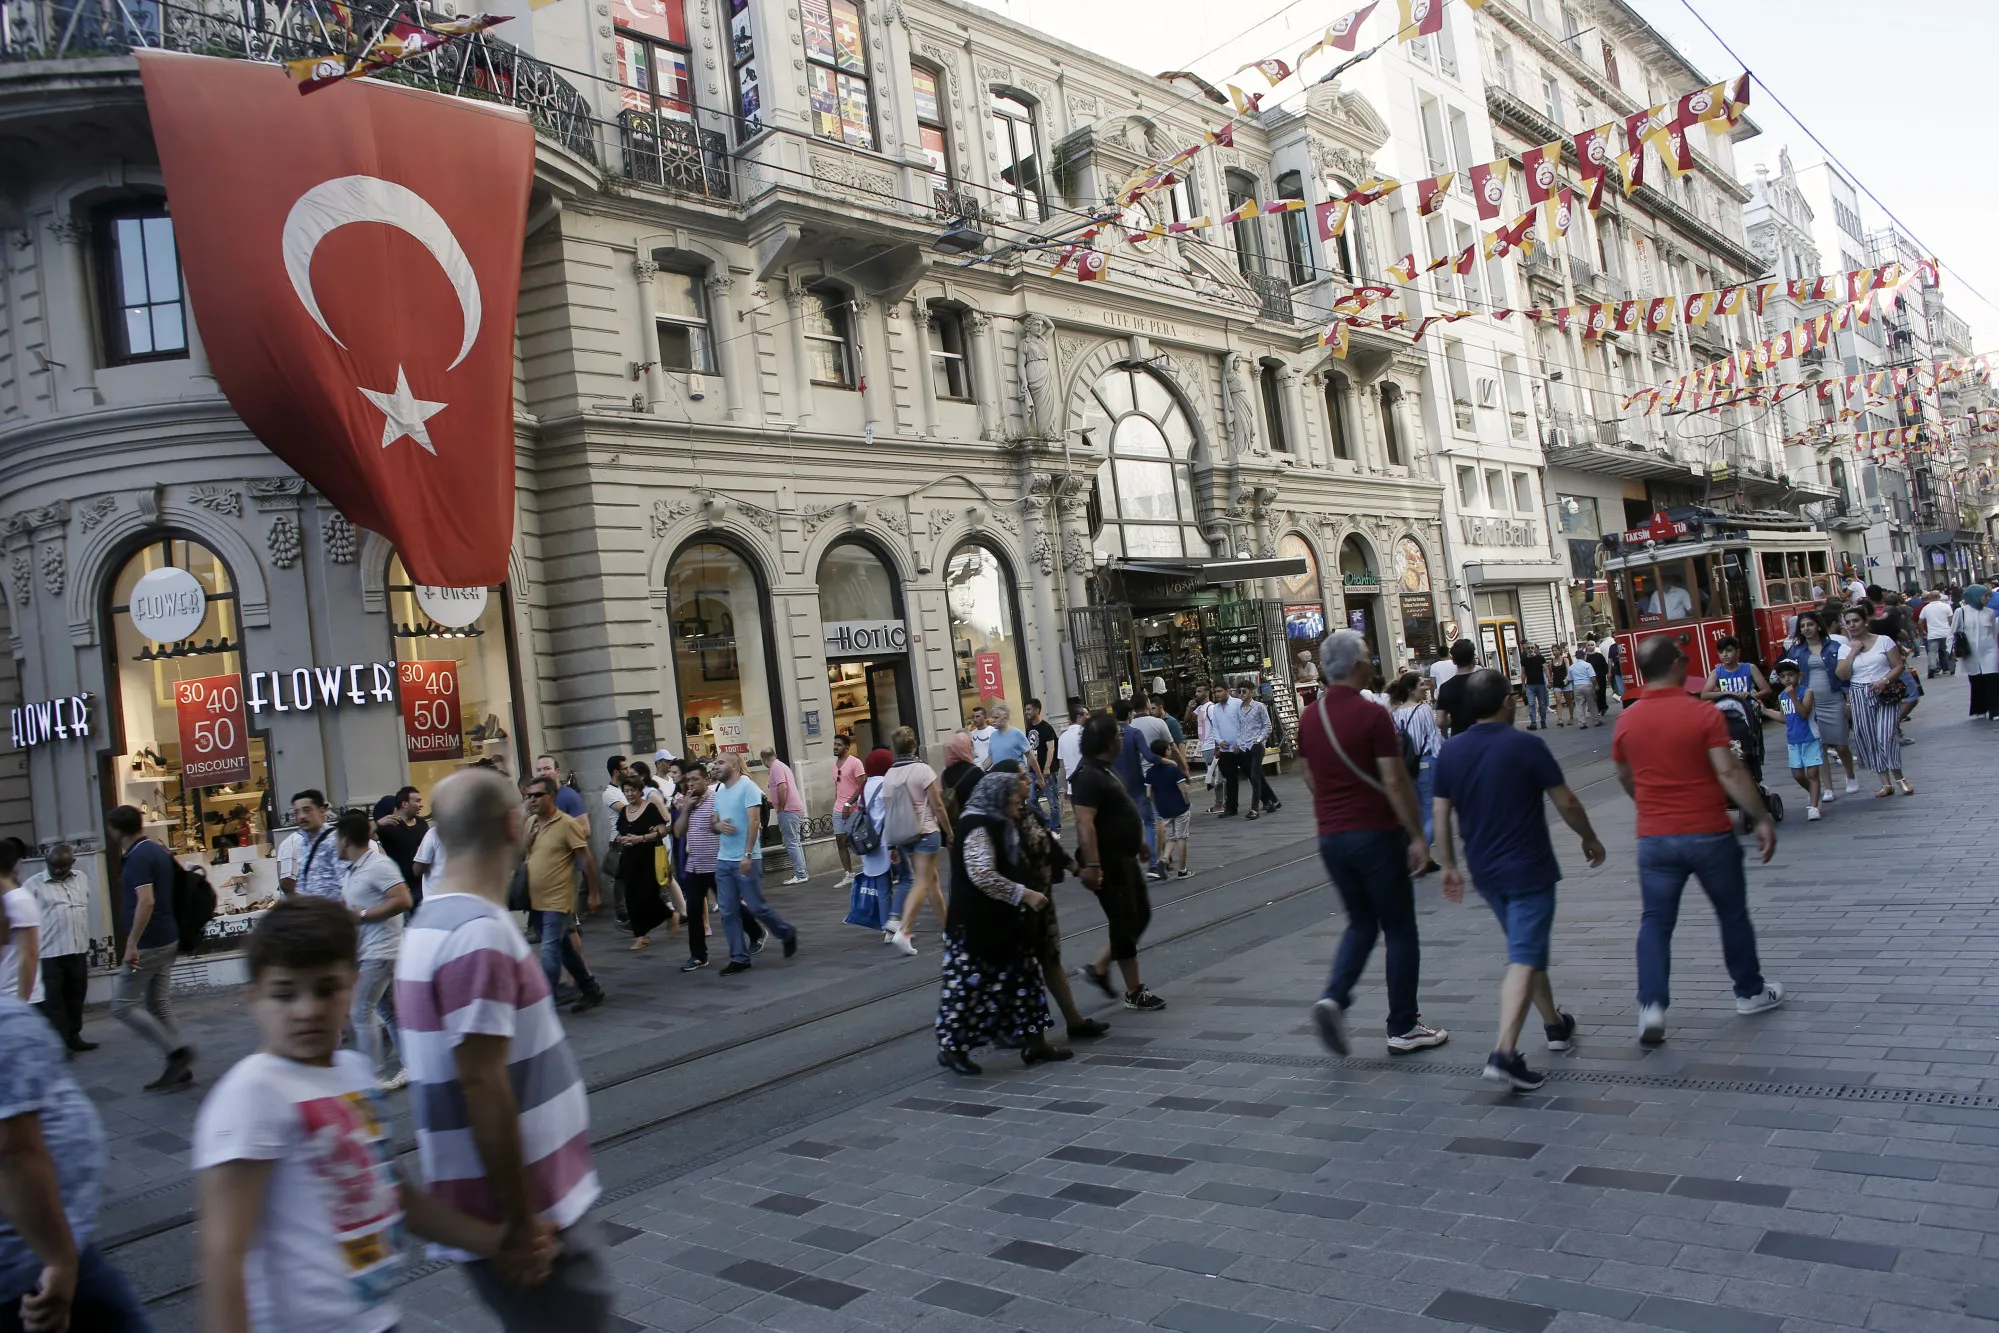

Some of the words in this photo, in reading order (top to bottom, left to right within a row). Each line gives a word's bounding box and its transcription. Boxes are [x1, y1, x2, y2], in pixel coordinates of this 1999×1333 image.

[1132, 316, 1148, 332] DE
[1150, 319, 1178, 338] PERA
[1654, 513, 1662, 524] 4
[1344, 569, 1377, 587] Otantik
[136, 588, 201, 621] FLOWER
[1711, 629, 1727, 641] 115
[401, 663, 424, 683] 30
[425, 671, 454, 695] 40
[984, 663, 995, 685] 5
[180, 682, 204, 704] 30
[1719, 676, 1749, 692] RUN
[206, 686, 238, 713] 40
[414, 699, 450, 730] 50
[195, 717, 235, 753] 50
[719, 725, 741, 736] %70
[407, 732, 460, 750] İNDİRİM
[186, 756, 246, 775] DISCOUNT
[1767, 990, 1777, 1001] N
